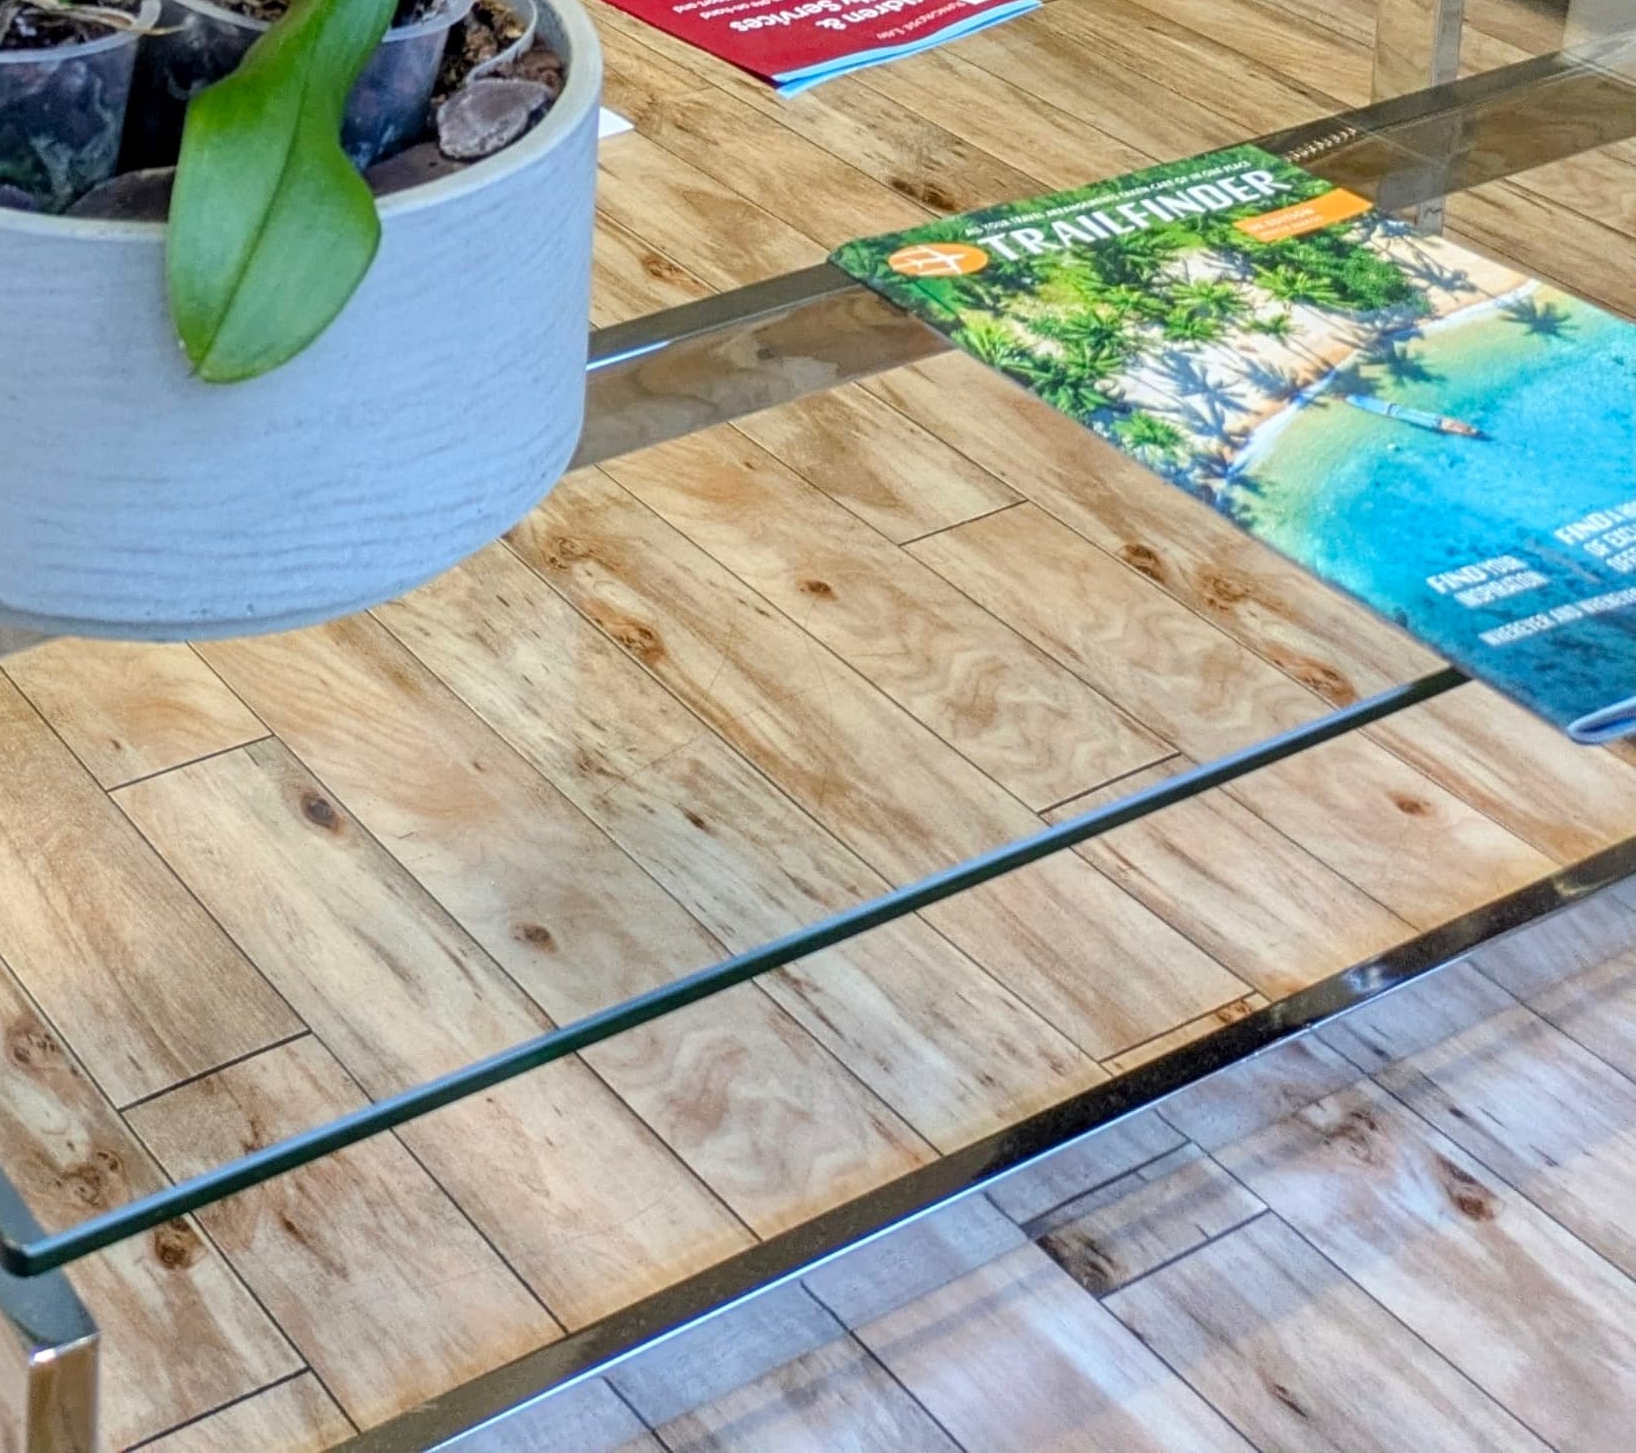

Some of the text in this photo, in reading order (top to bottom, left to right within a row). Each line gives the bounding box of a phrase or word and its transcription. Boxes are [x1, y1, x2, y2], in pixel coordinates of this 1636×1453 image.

[730, 0, 842, 31] Services
[815, 18, 846, 30] &
[977, 169, 1293, 262] TRAILFINDER
[1554, 512, 1613, 546] FIND
[1426, 564, 1489, 595] FIND
[1477, 612, 1559, 646] WHEREVER
